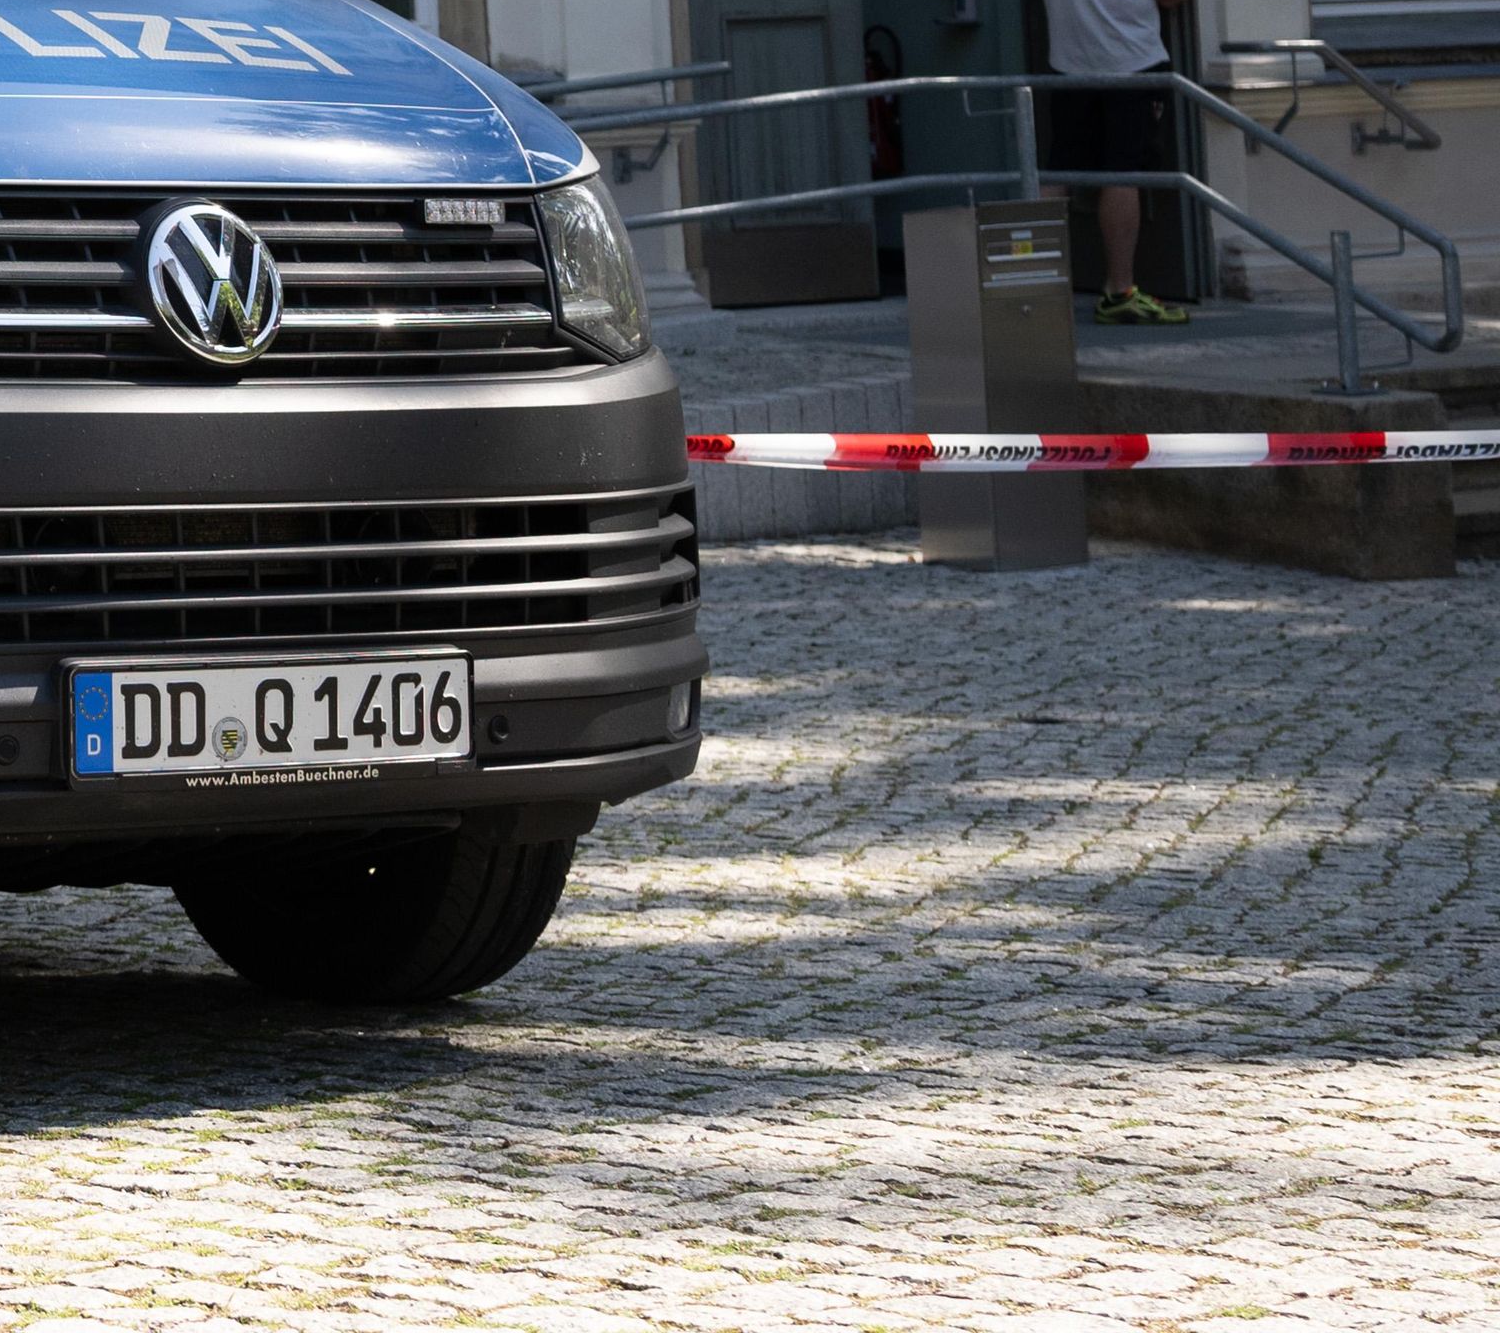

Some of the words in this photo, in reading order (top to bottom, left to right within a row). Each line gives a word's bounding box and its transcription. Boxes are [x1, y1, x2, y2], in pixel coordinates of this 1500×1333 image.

[86, 732, 101, 755] D
[120, 681, 206, 759] DD
[255, 677, 295, 753] Q
[313, 670, 462, 751] 1406
[186, 765, 379, 787] www.AmbestenBuechner.de
